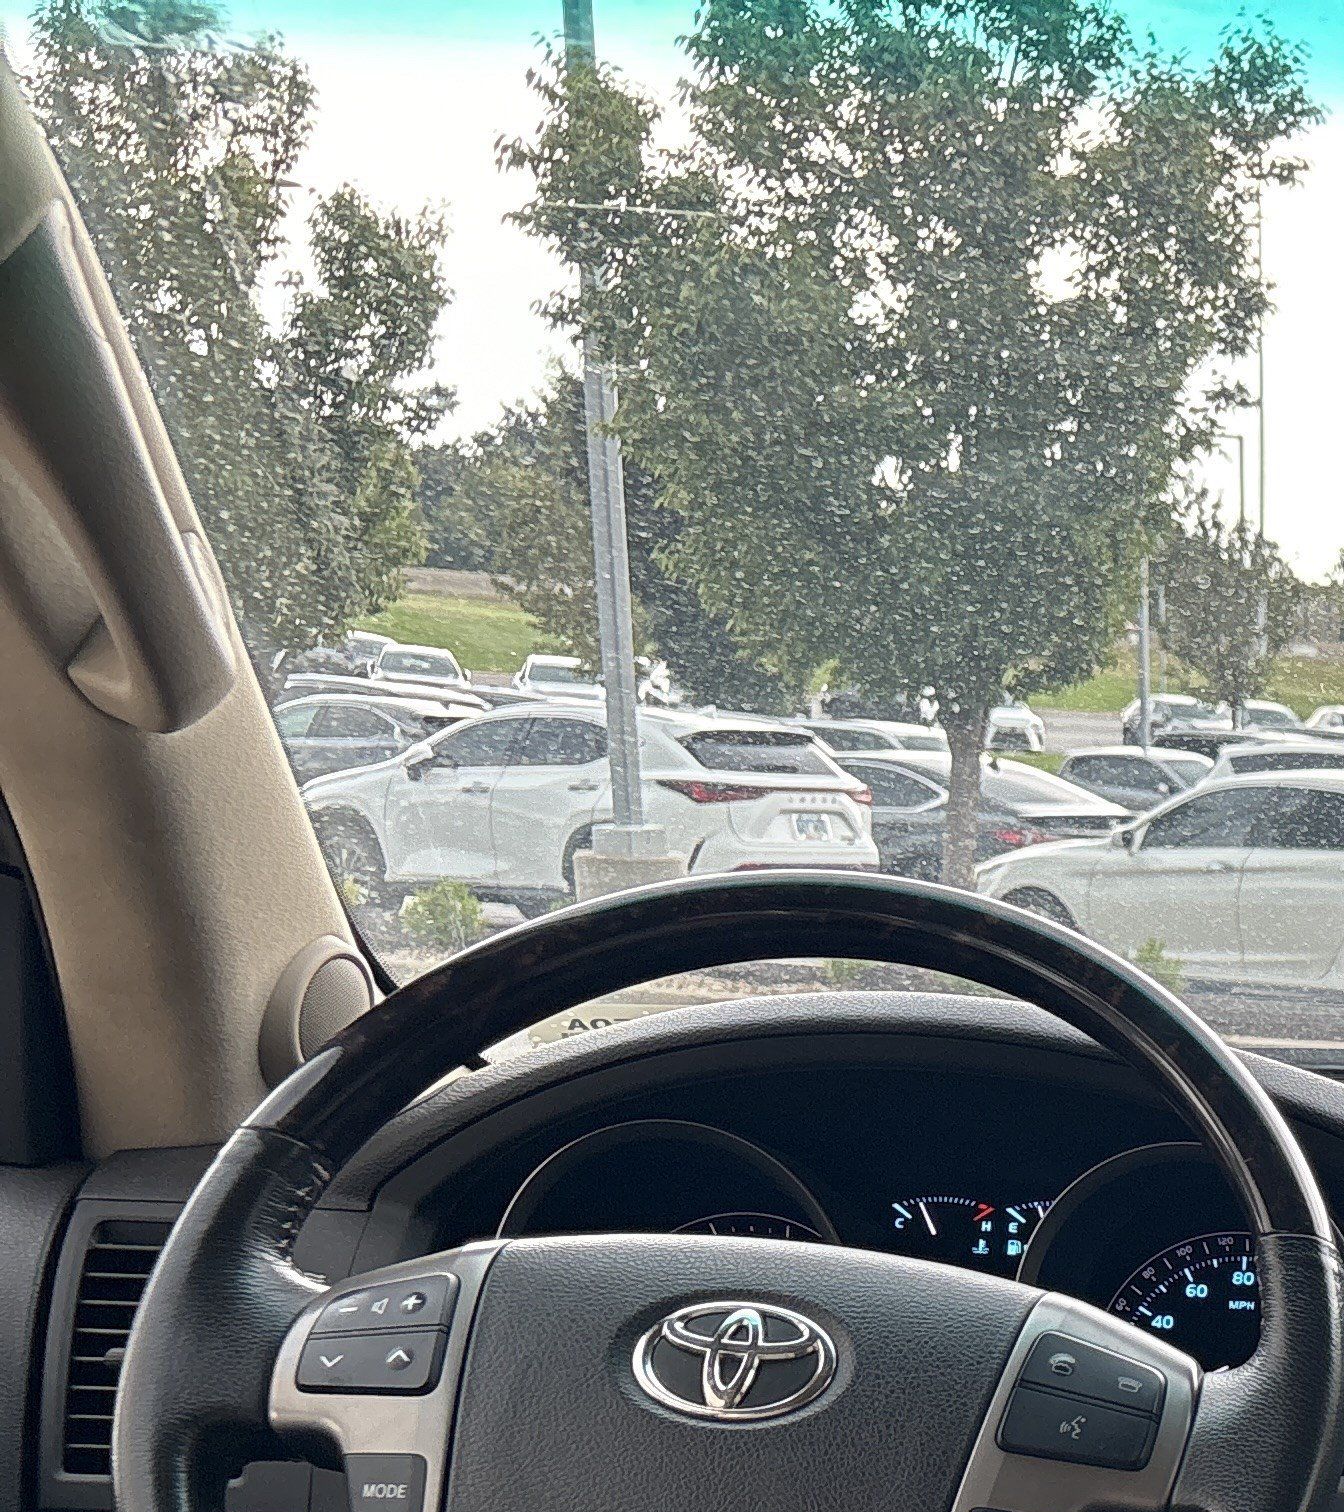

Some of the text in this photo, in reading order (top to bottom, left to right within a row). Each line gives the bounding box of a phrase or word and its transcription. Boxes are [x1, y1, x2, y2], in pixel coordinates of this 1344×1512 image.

[894, 1217, 905, 1229] C
[980, 1220, 992, 1232] H
[1008, 1221, 1019, 1234] E
[1217, 1236, 1234, 1246] 120
[1176, 1245, 1193, 1258] 100
[1231, 1271, 1255, 1286] 80
[1185, 1283, 1208, 1298] 60
[1228, 1300, 1255, 1311] MPH
[1151, 1315, 1174, 1329] 40
[363, 1483, 408, 1499] MODE
